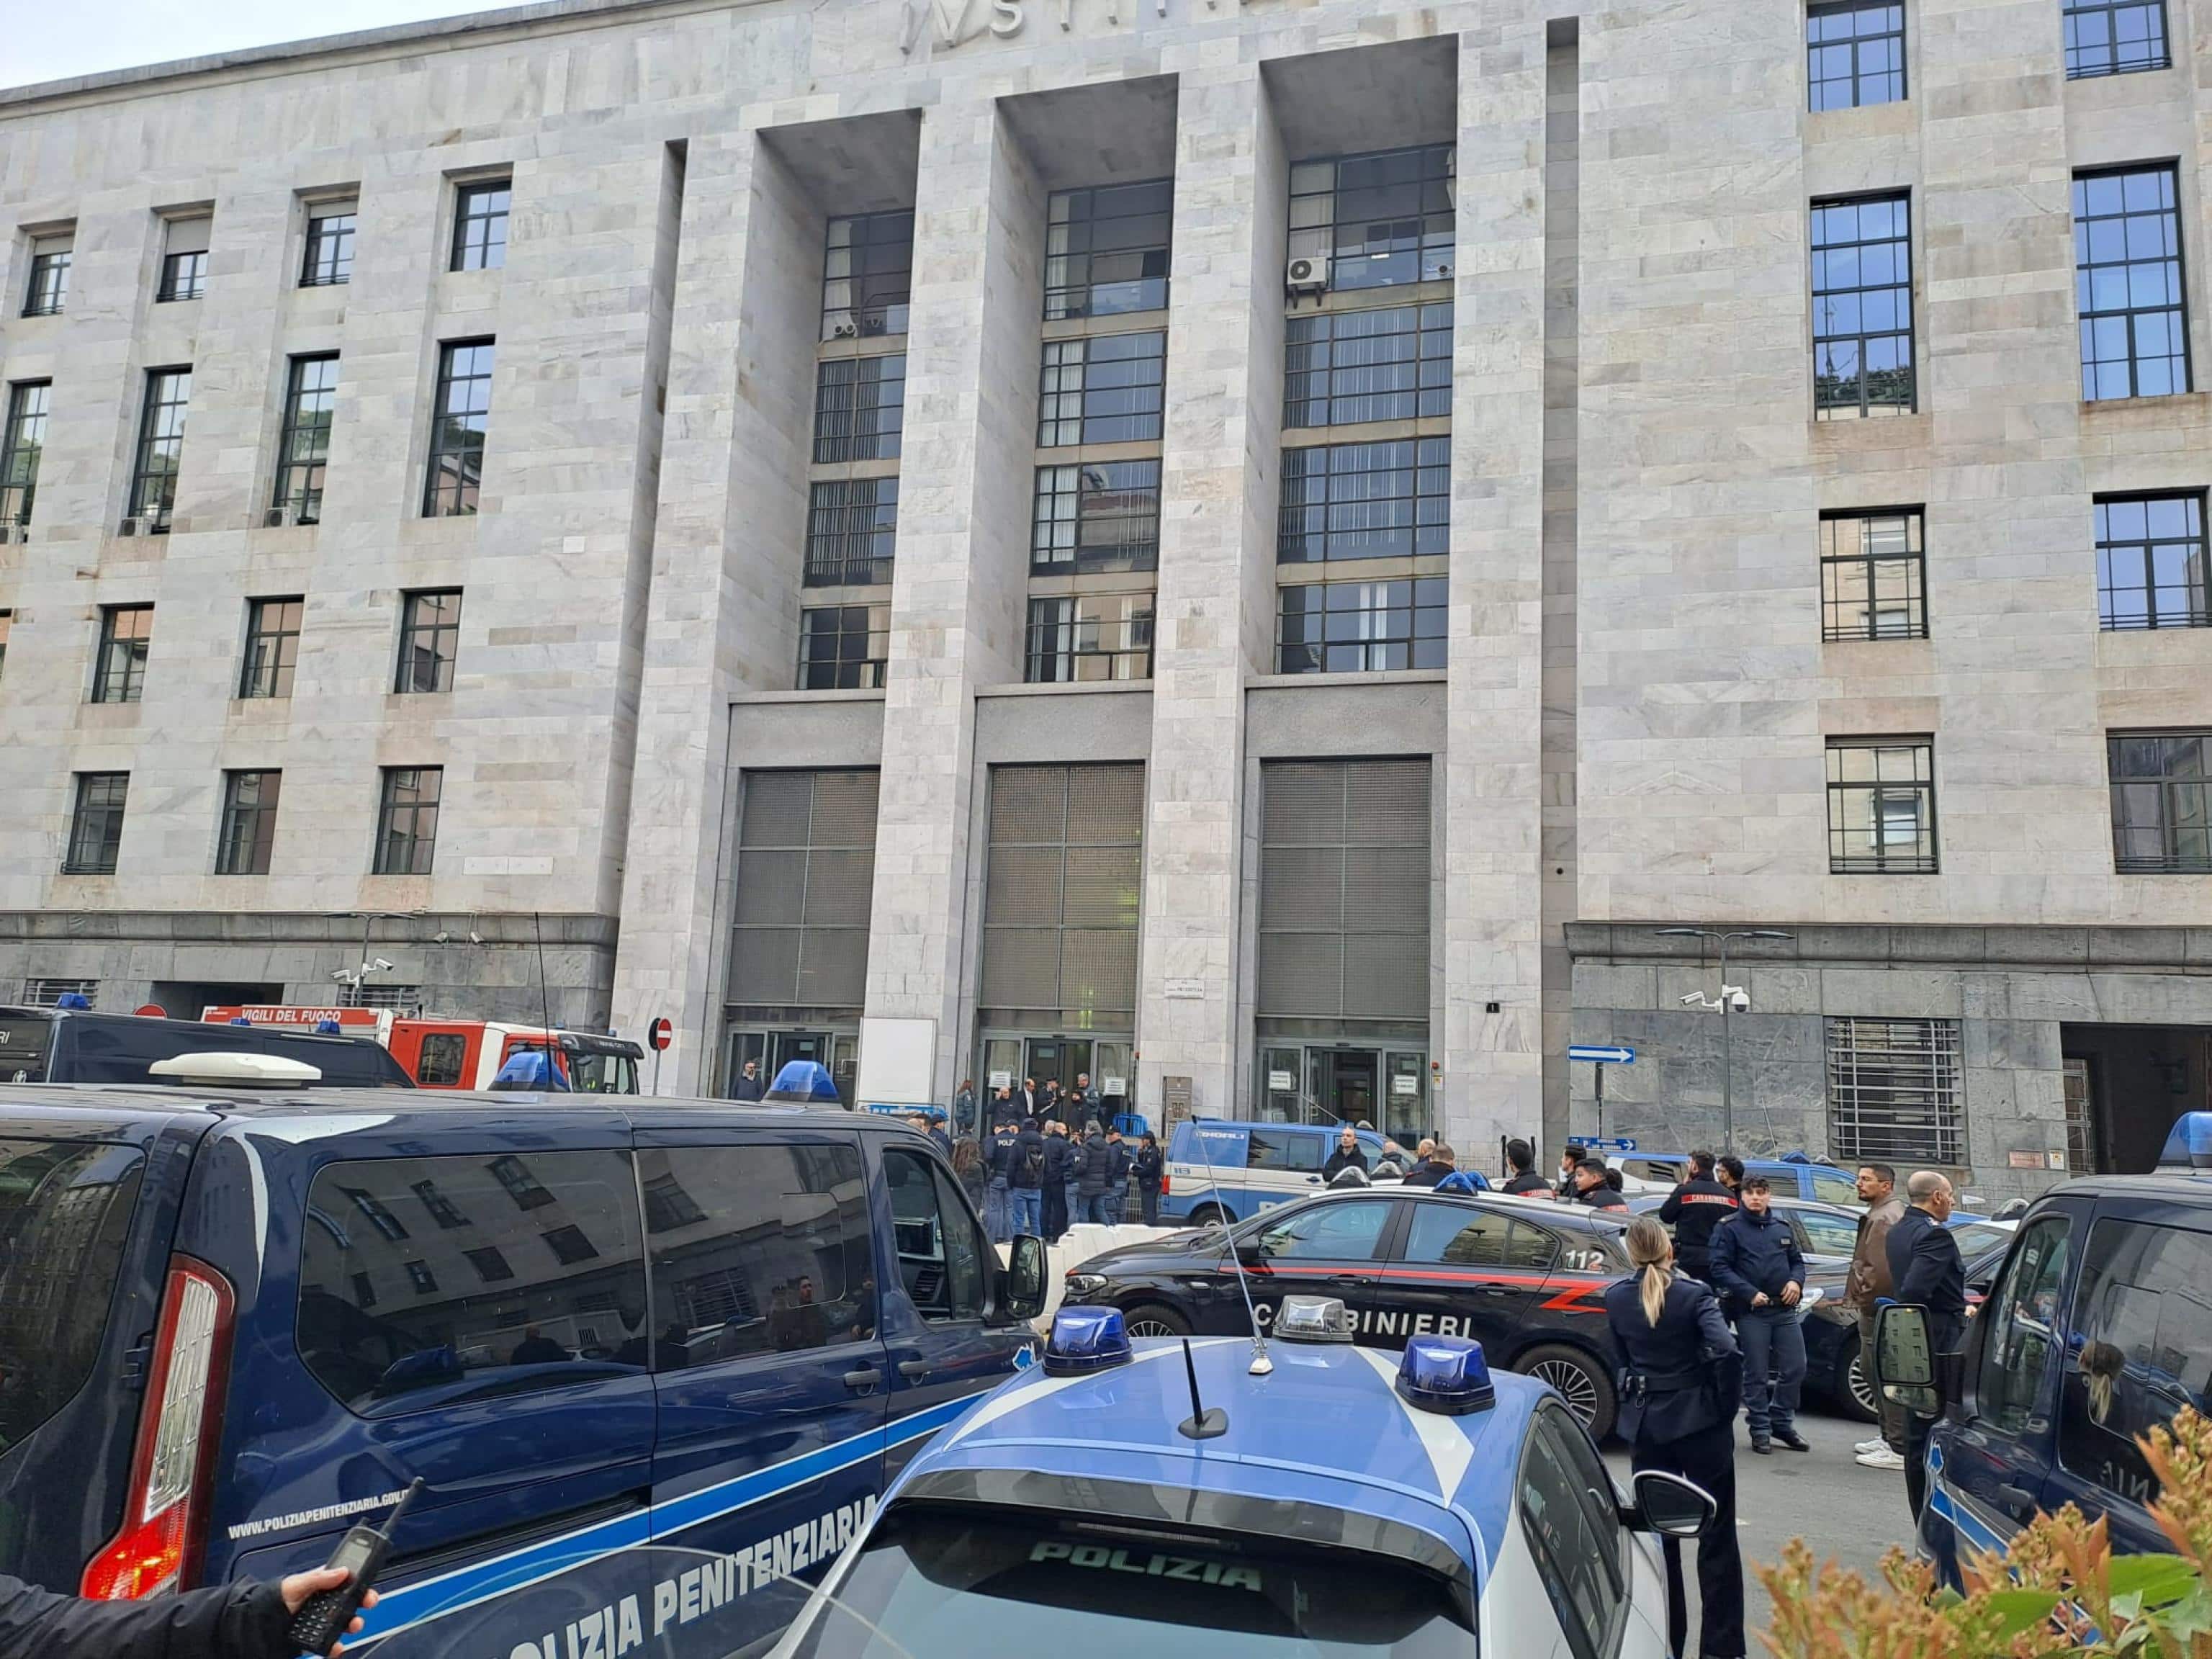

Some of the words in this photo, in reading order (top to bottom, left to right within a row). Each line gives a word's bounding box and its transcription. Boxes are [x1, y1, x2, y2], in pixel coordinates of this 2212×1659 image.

[241, 1009, 274, 1022] VIGILI
[276, 1010, 297, 1022] DEL
[300, 1010, 341, 1022] FUOCO
[1565, 1249, 1604, 1270] 112
[1253, 1303, 1472, 1339] CBINIERI
[493, 1593, 643, 1659] IZIA
[654, 1493, 878, 1637] PENITENZIARIA
[1028, 1541, 1262, 1592] POLIZIA
